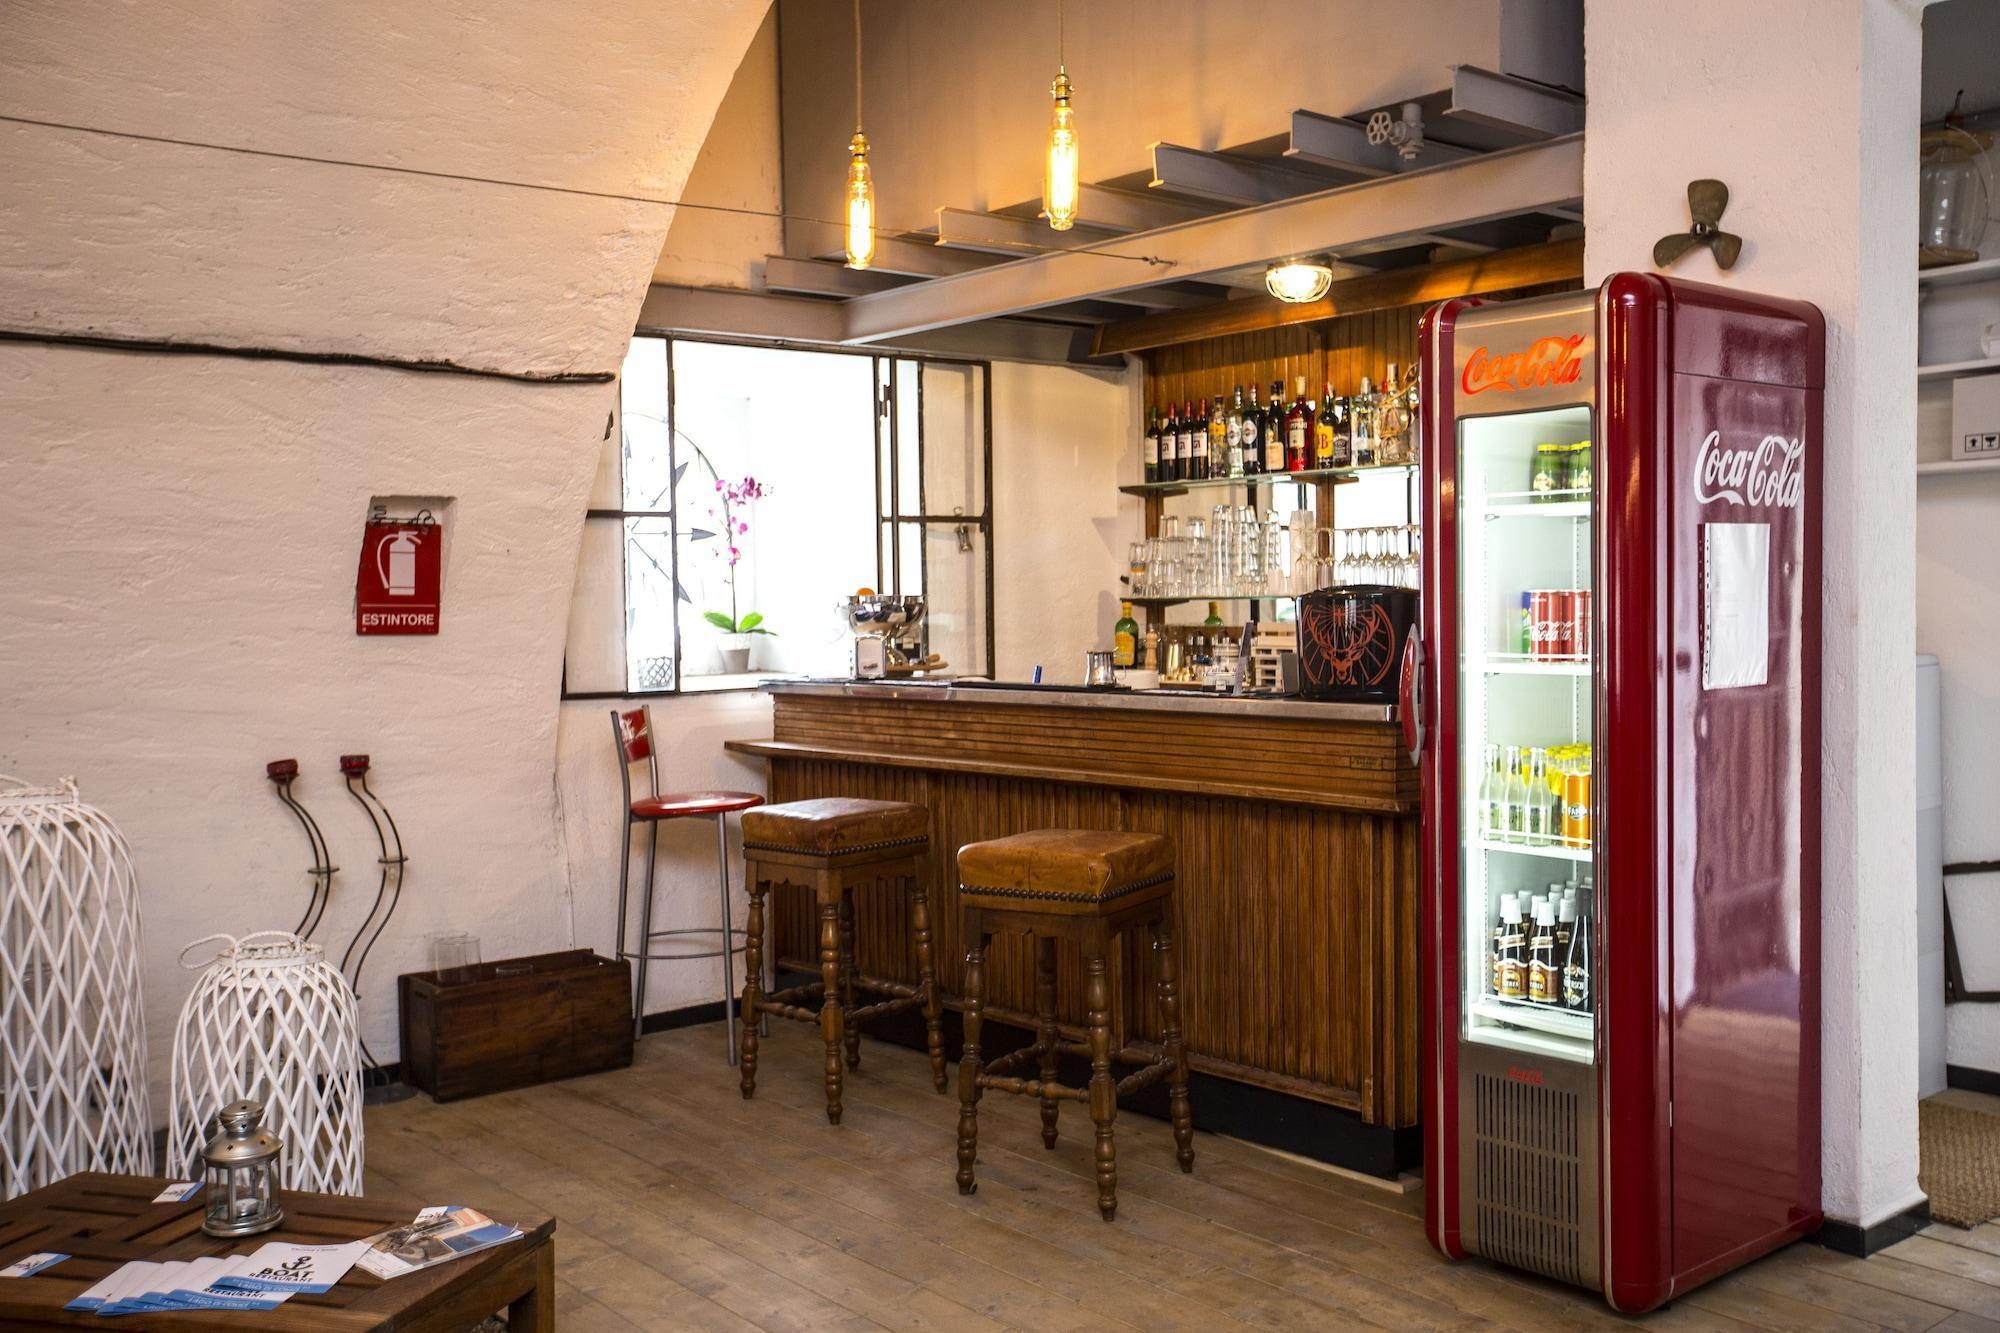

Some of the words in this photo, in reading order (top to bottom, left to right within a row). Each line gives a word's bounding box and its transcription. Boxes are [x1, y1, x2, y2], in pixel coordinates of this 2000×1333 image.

[1462, 333, 1586, 395] Coca-Cola
[1694, 430, 1805, 508] Coca-Cola
[362, 613, 435, 626] ESTINTORE
[248, 1272, 313, 1282] RESTAURANT
[260, 1267, 316, 1279] BOAT
[201, 1287, 264, 1298] RESTAURANT
